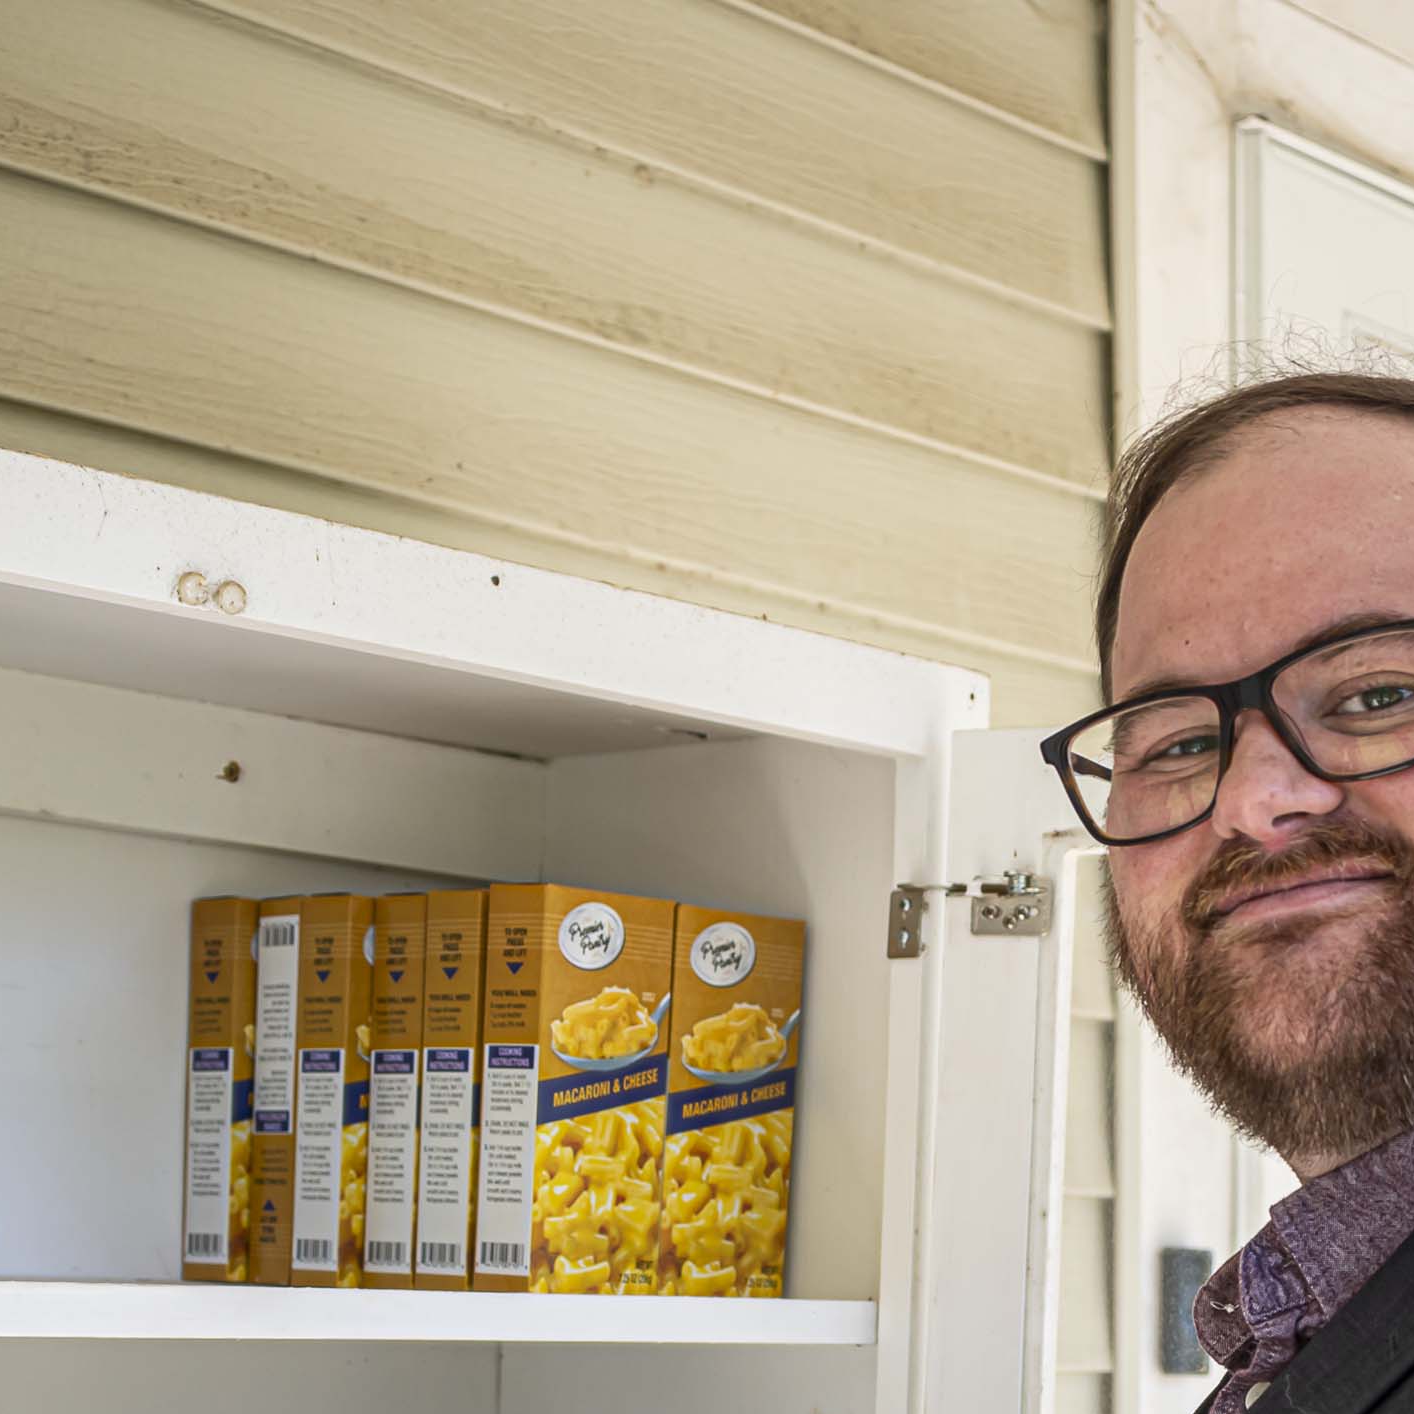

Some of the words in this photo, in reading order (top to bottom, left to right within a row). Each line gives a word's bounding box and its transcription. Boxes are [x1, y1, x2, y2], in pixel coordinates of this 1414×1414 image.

[553, 1081, 611, 1107] MACARONI
[613, 1079, 620, 1094] &
[622, 1068, 659, 1091] CHEESE
[682, 1091, 738, 1118] MACARONI
[740, 1090, 748, 1105] &
[750, 1081, 786, 1102] CHEESE
